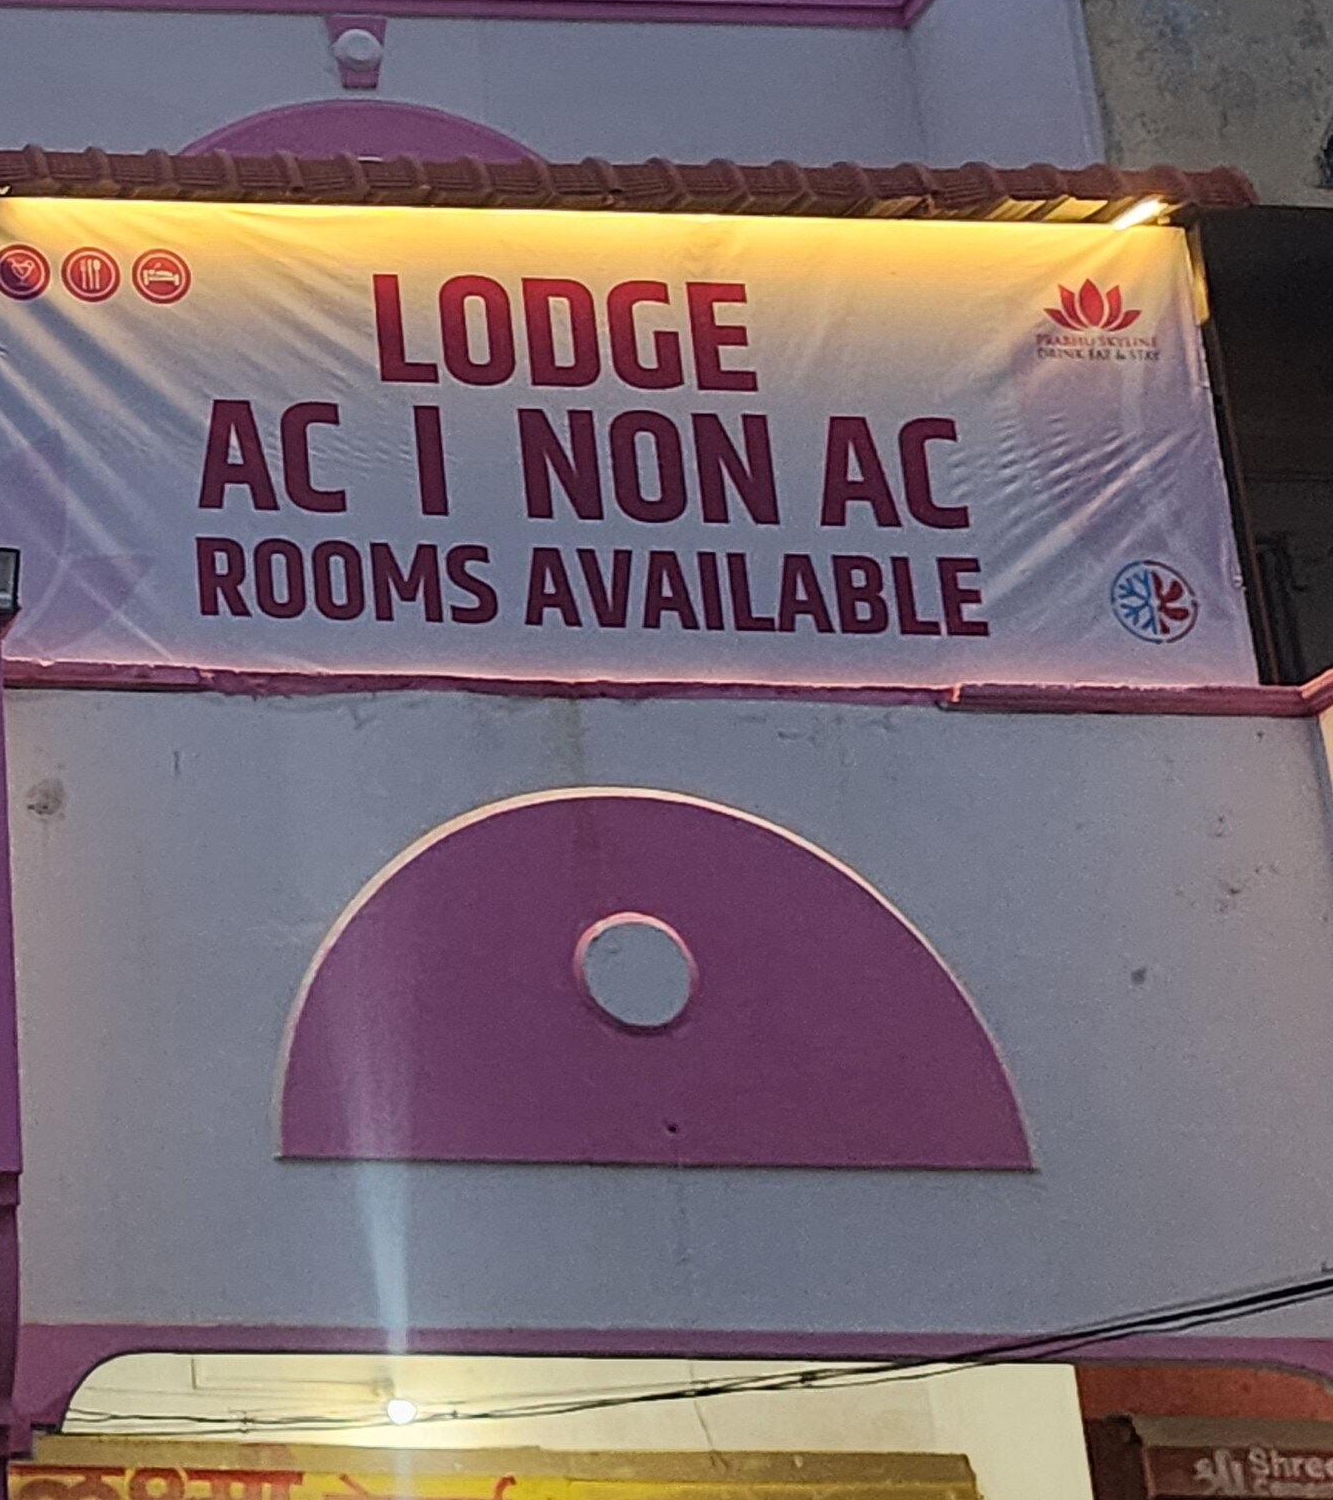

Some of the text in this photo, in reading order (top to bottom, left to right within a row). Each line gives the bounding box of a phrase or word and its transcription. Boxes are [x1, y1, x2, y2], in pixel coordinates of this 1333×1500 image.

[373, 273, 759, 393] LODGE
[198, 399, 348, 514] AC
[517, 408, 781, 526] NON
[820, 415, 971, 530] AC
[195, 536, 991, 638] ROOMS AVAILABLE
